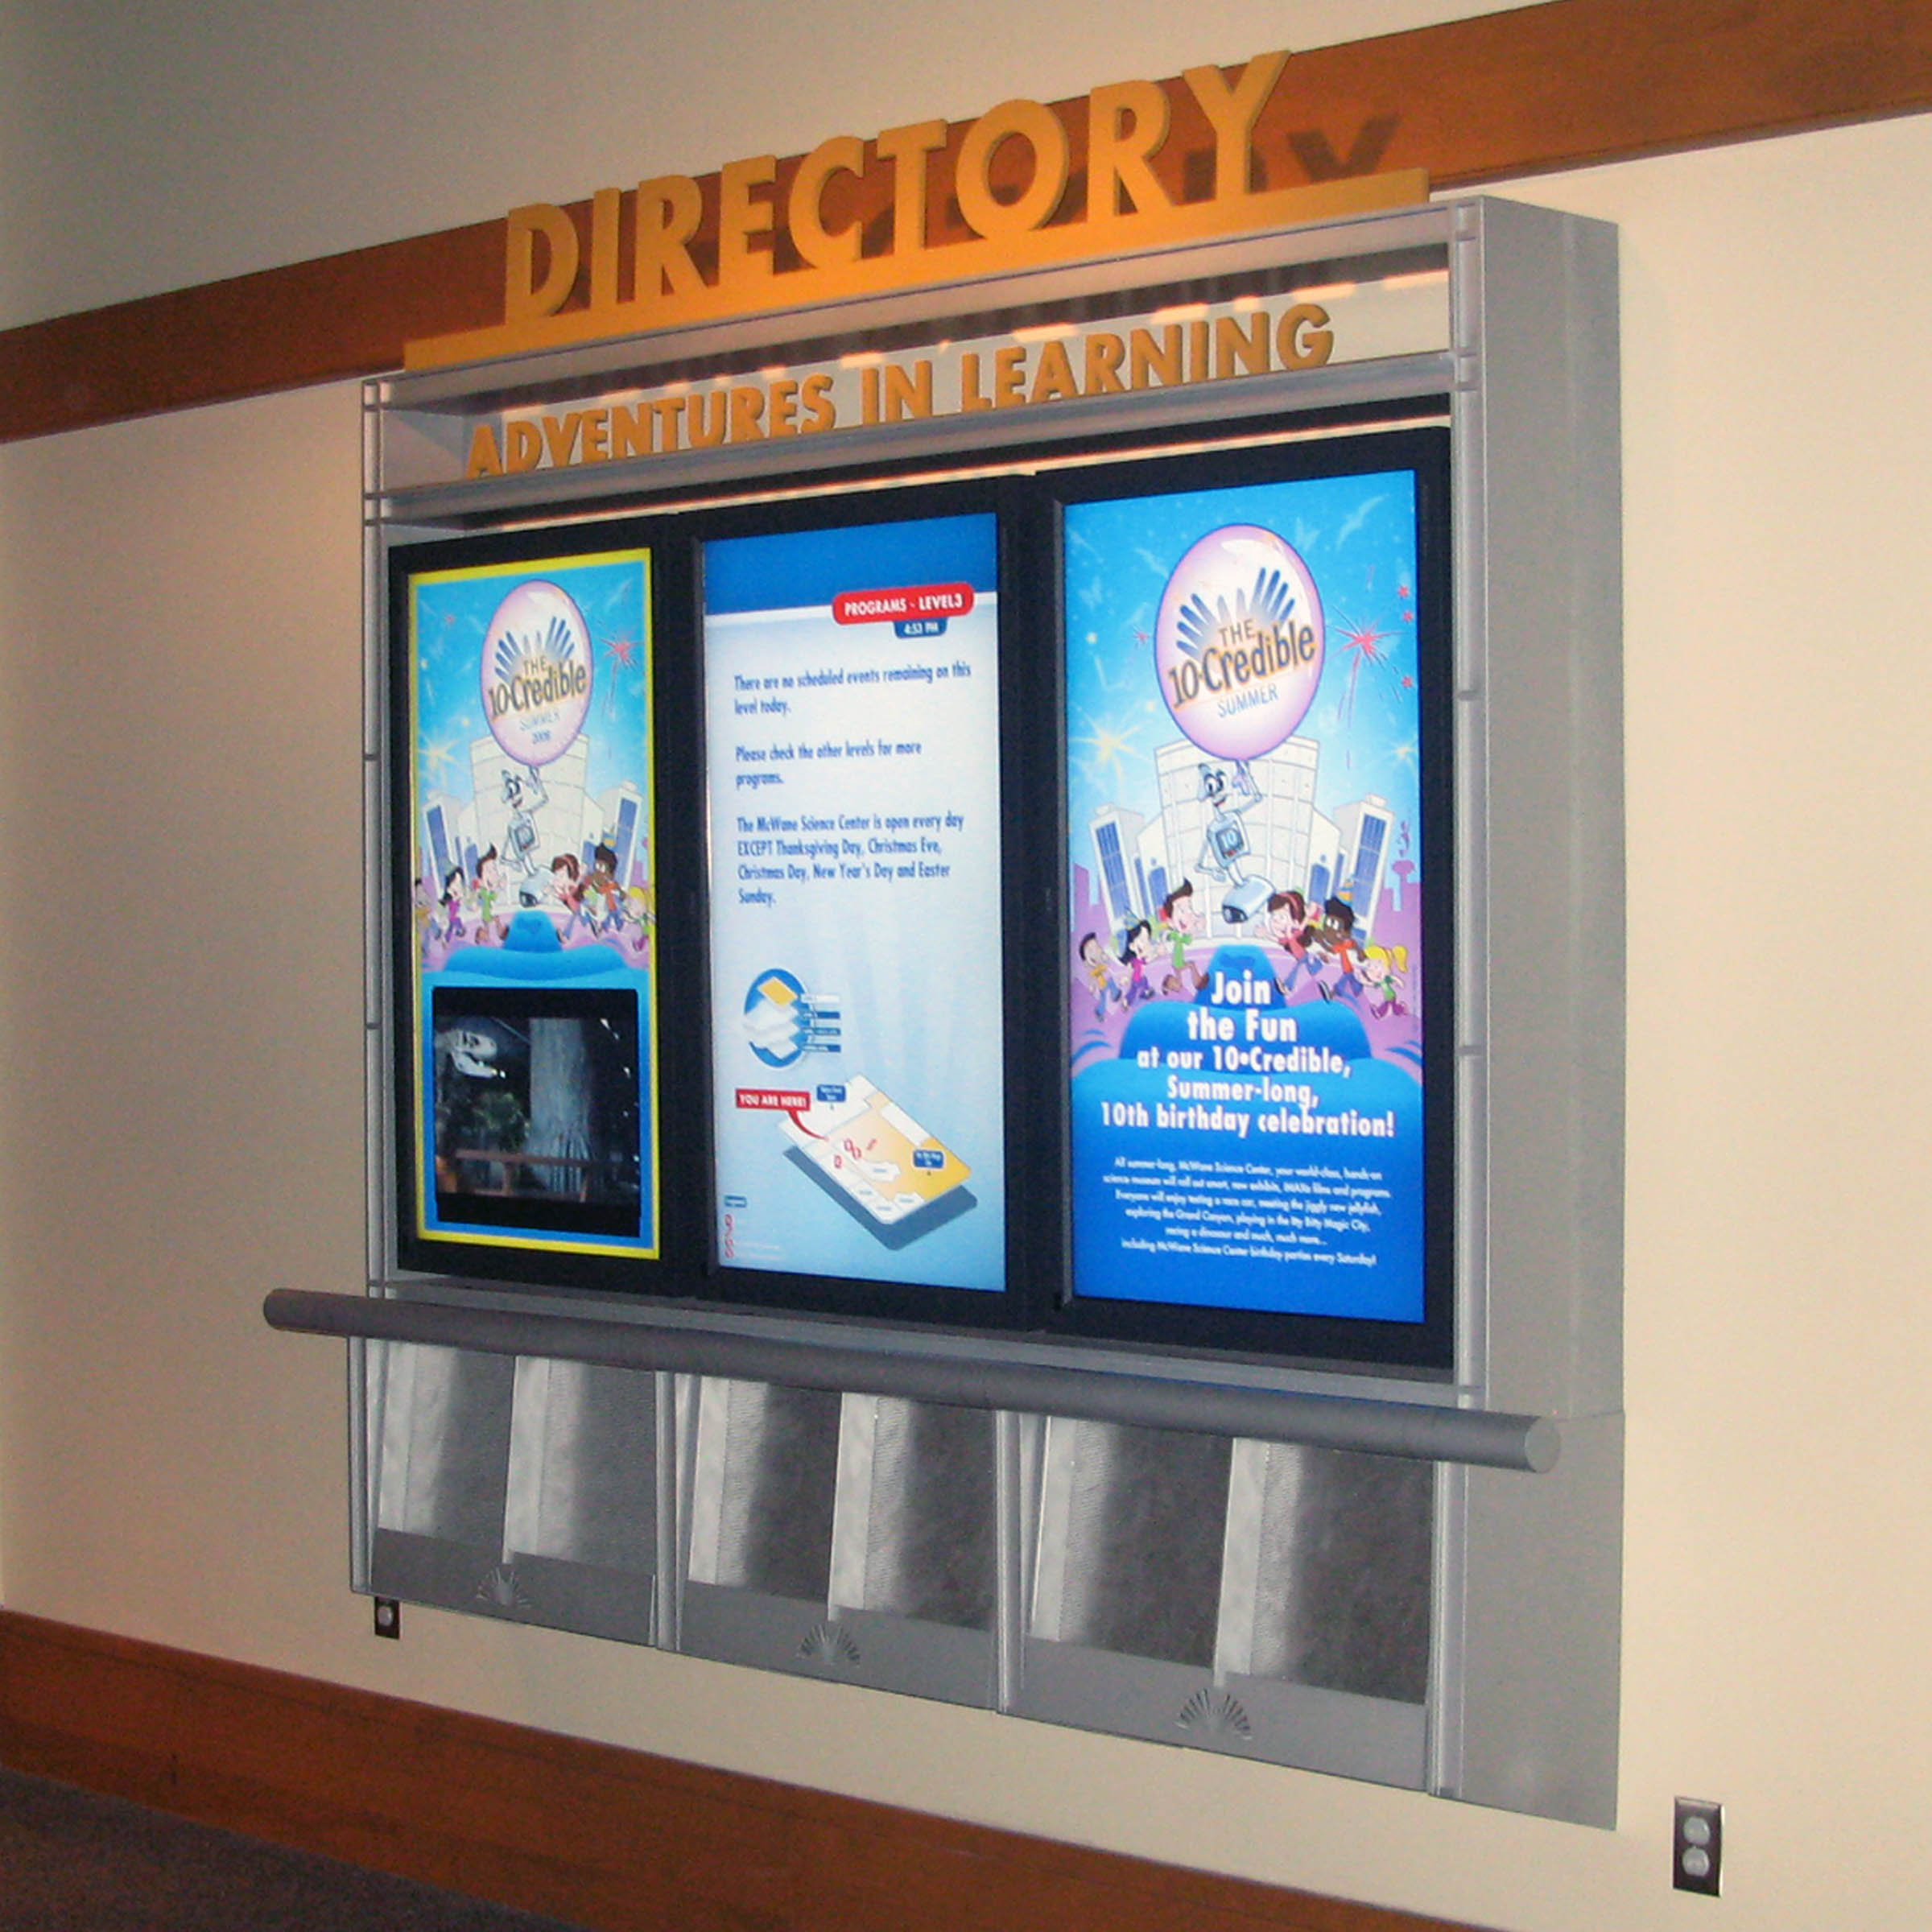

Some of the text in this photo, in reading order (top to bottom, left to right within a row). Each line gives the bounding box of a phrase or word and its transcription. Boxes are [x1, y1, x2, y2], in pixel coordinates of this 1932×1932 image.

[505, 49, 1290, 324] DIRECTORY
[466, 303, 1334, 480] ADVENTURES IN LEARNING
[844, 597, 907, 617] PROGRAMS
[926, 621, 939, 633] PM
[1219, 618, 1257, 647] THE
[523, 655, 547, 675] THE
[734, 659, 972, 691] There are no scheduled events remaining on this
[734, 696, 791, 717] level today.
[1217, 683, 1279, 719] SUMMER
[735, 738, 922, 762] Please check the other levels for more
[735, 773, 784, 791] programs.
[737, 809, 964, 833] The McWane Science Center is open every day
[737, 836, 942, 860] EXCEPT Thanksgiving Day, Christmas Eve,
[738, 861, 950, 884] Christmas Day, New Year's Day and Easter
[738, 887, 776, 908] Sunday.
[1211, 969, 1271, 1005] Join
[1187, 1006, 1298, 1042] the Fun
[1137, 1047, 1160, 1068] at
[1166, 1049, 1203, 1070] our
[739, 1093, 760, 1106] YOU
[761, 1094, 778, 1107] ARE
[1166, 1075, 1319, 1109] Summer-long,
[1101, 1102, 1395, 1138] 10th birthday celebration!
